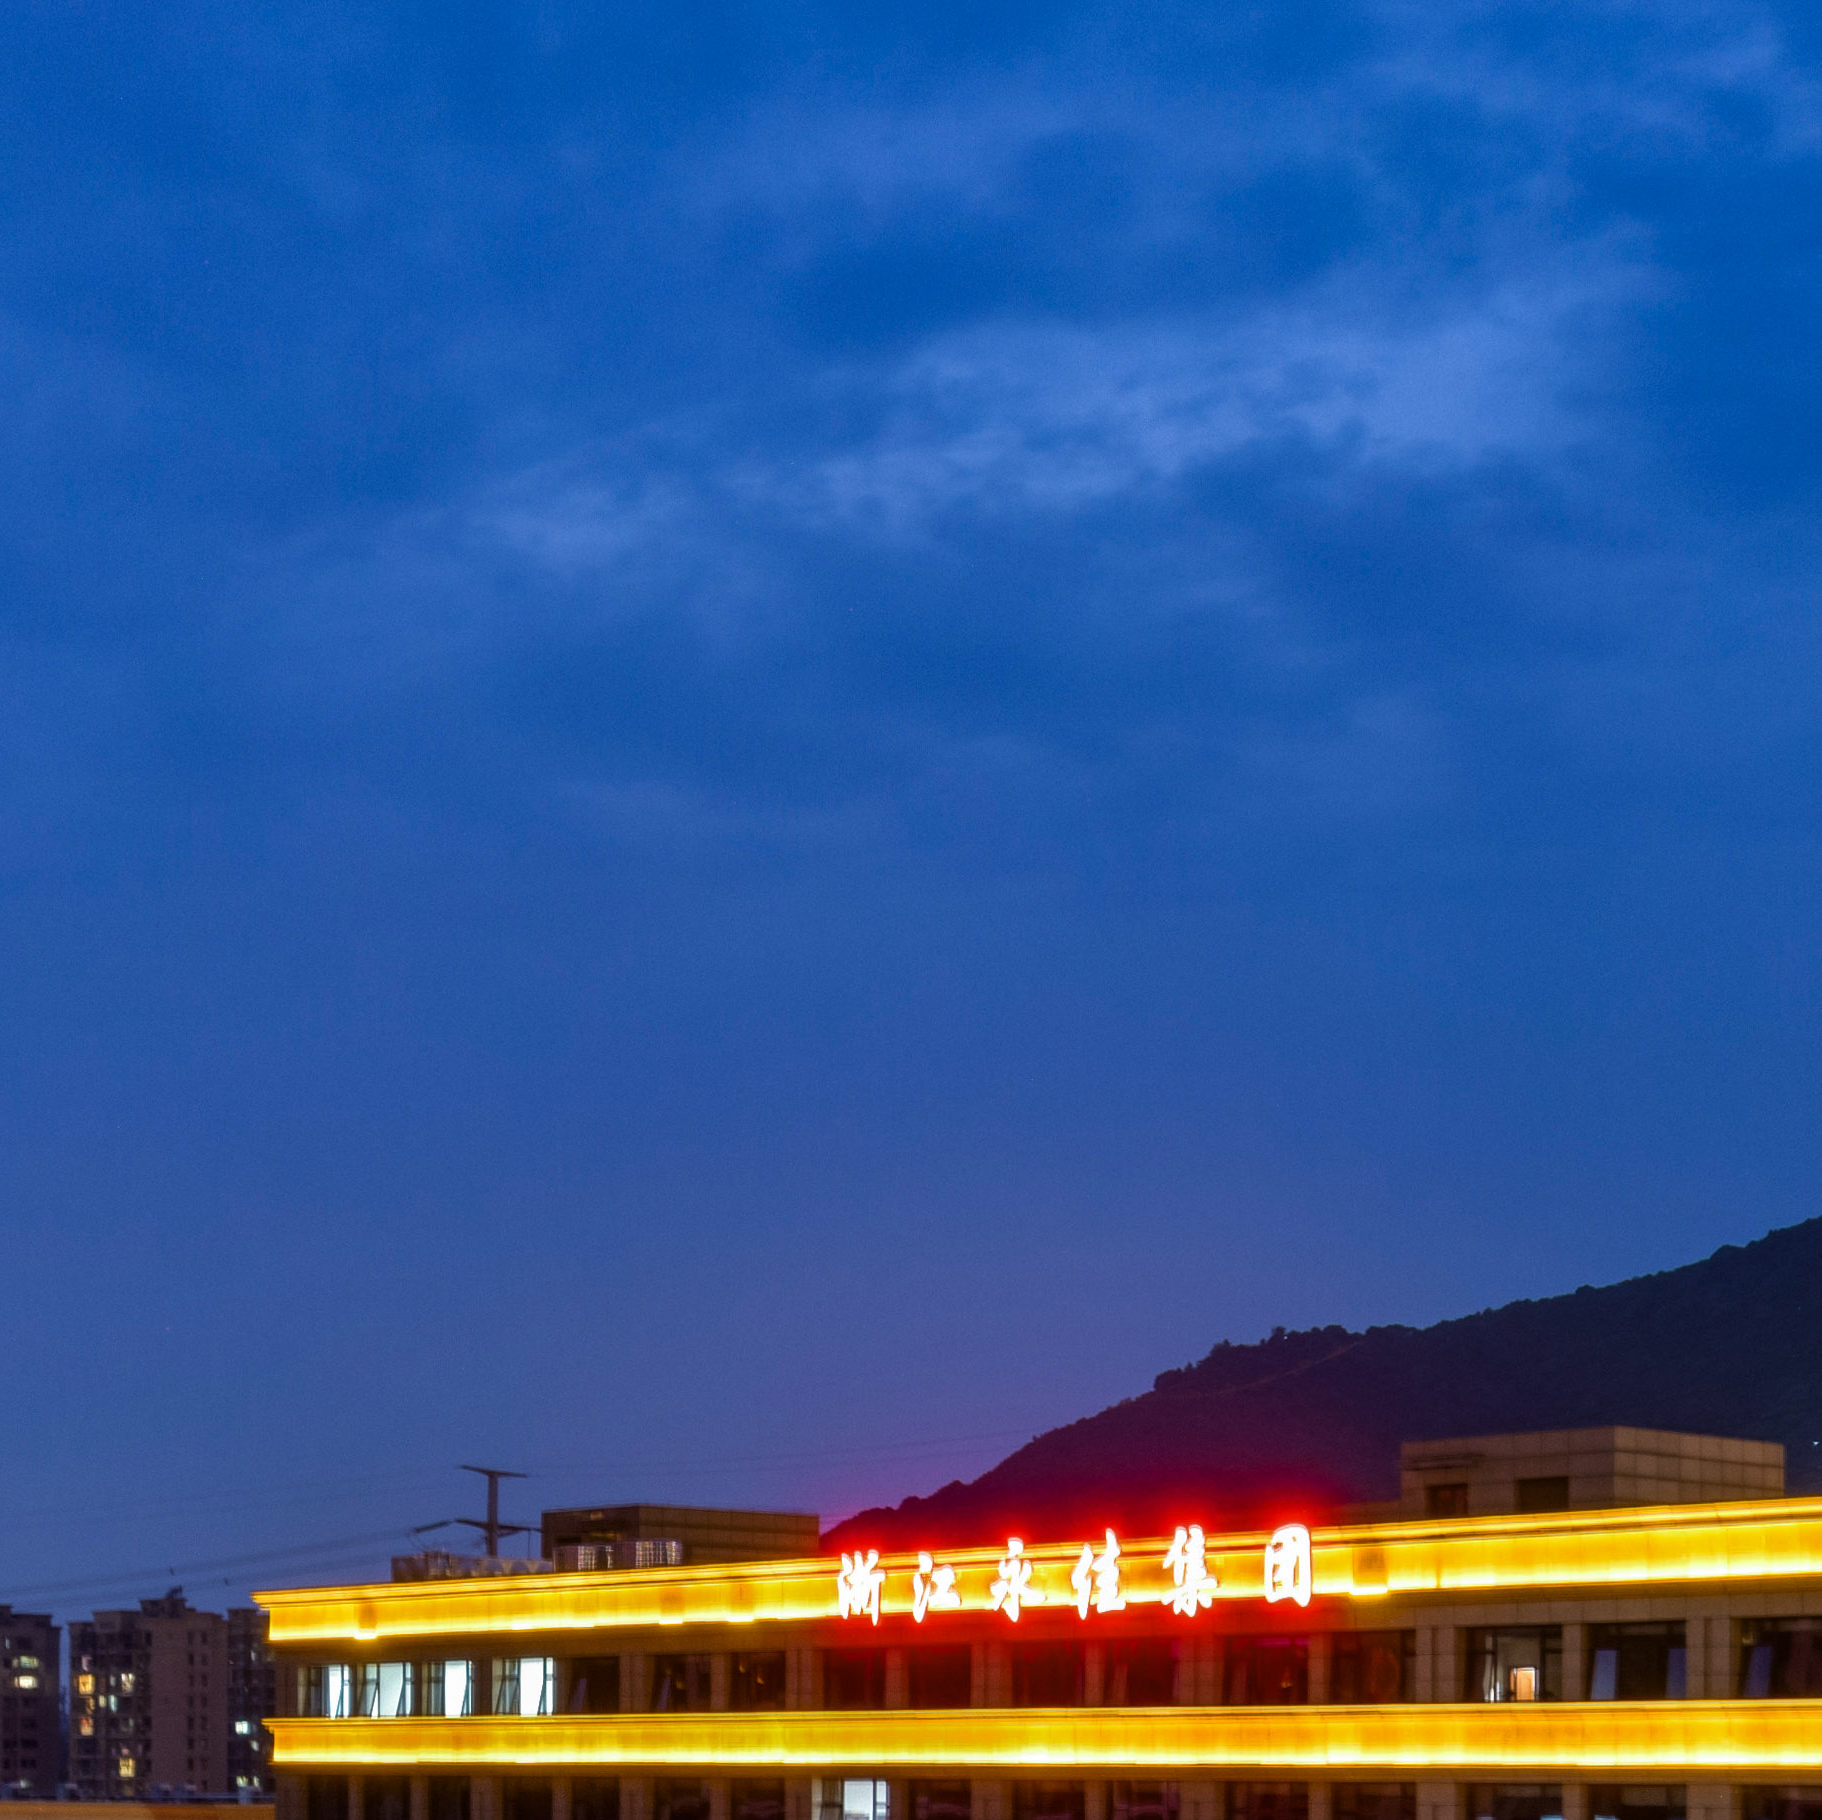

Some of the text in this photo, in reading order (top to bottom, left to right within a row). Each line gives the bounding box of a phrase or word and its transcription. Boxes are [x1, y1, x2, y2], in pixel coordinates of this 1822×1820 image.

[837, 1524, 1312, 1625] 浙江永佳集团
